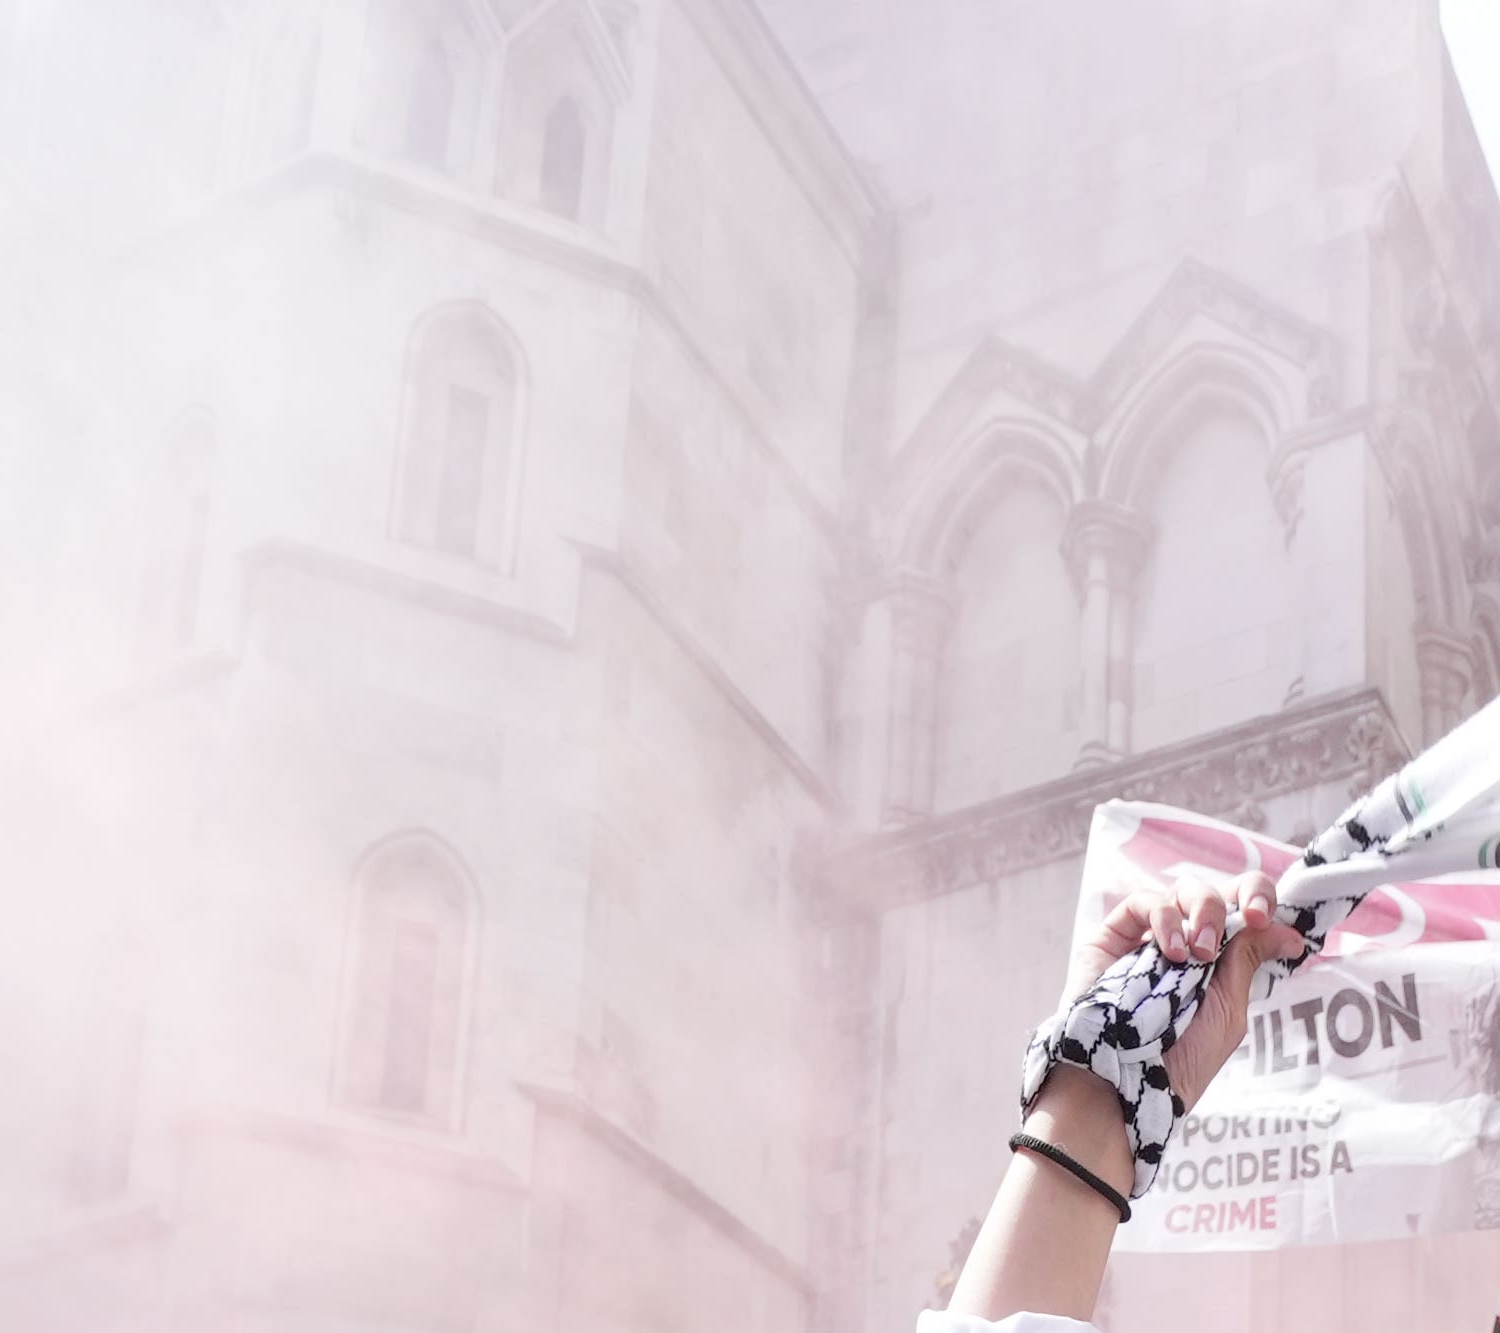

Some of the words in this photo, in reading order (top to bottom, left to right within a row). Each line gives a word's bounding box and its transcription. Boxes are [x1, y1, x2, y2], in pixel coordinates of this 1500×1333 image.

[1181, 1100, 1342, 1147] PORTING
[1156, 1148, 1280, 1194] NOCIDE
[1289, 1143, 1321, 1181] IS
[1329, 1139, 1354, 1175] A
[1164, 1195, 1278, 1235] CRIME
